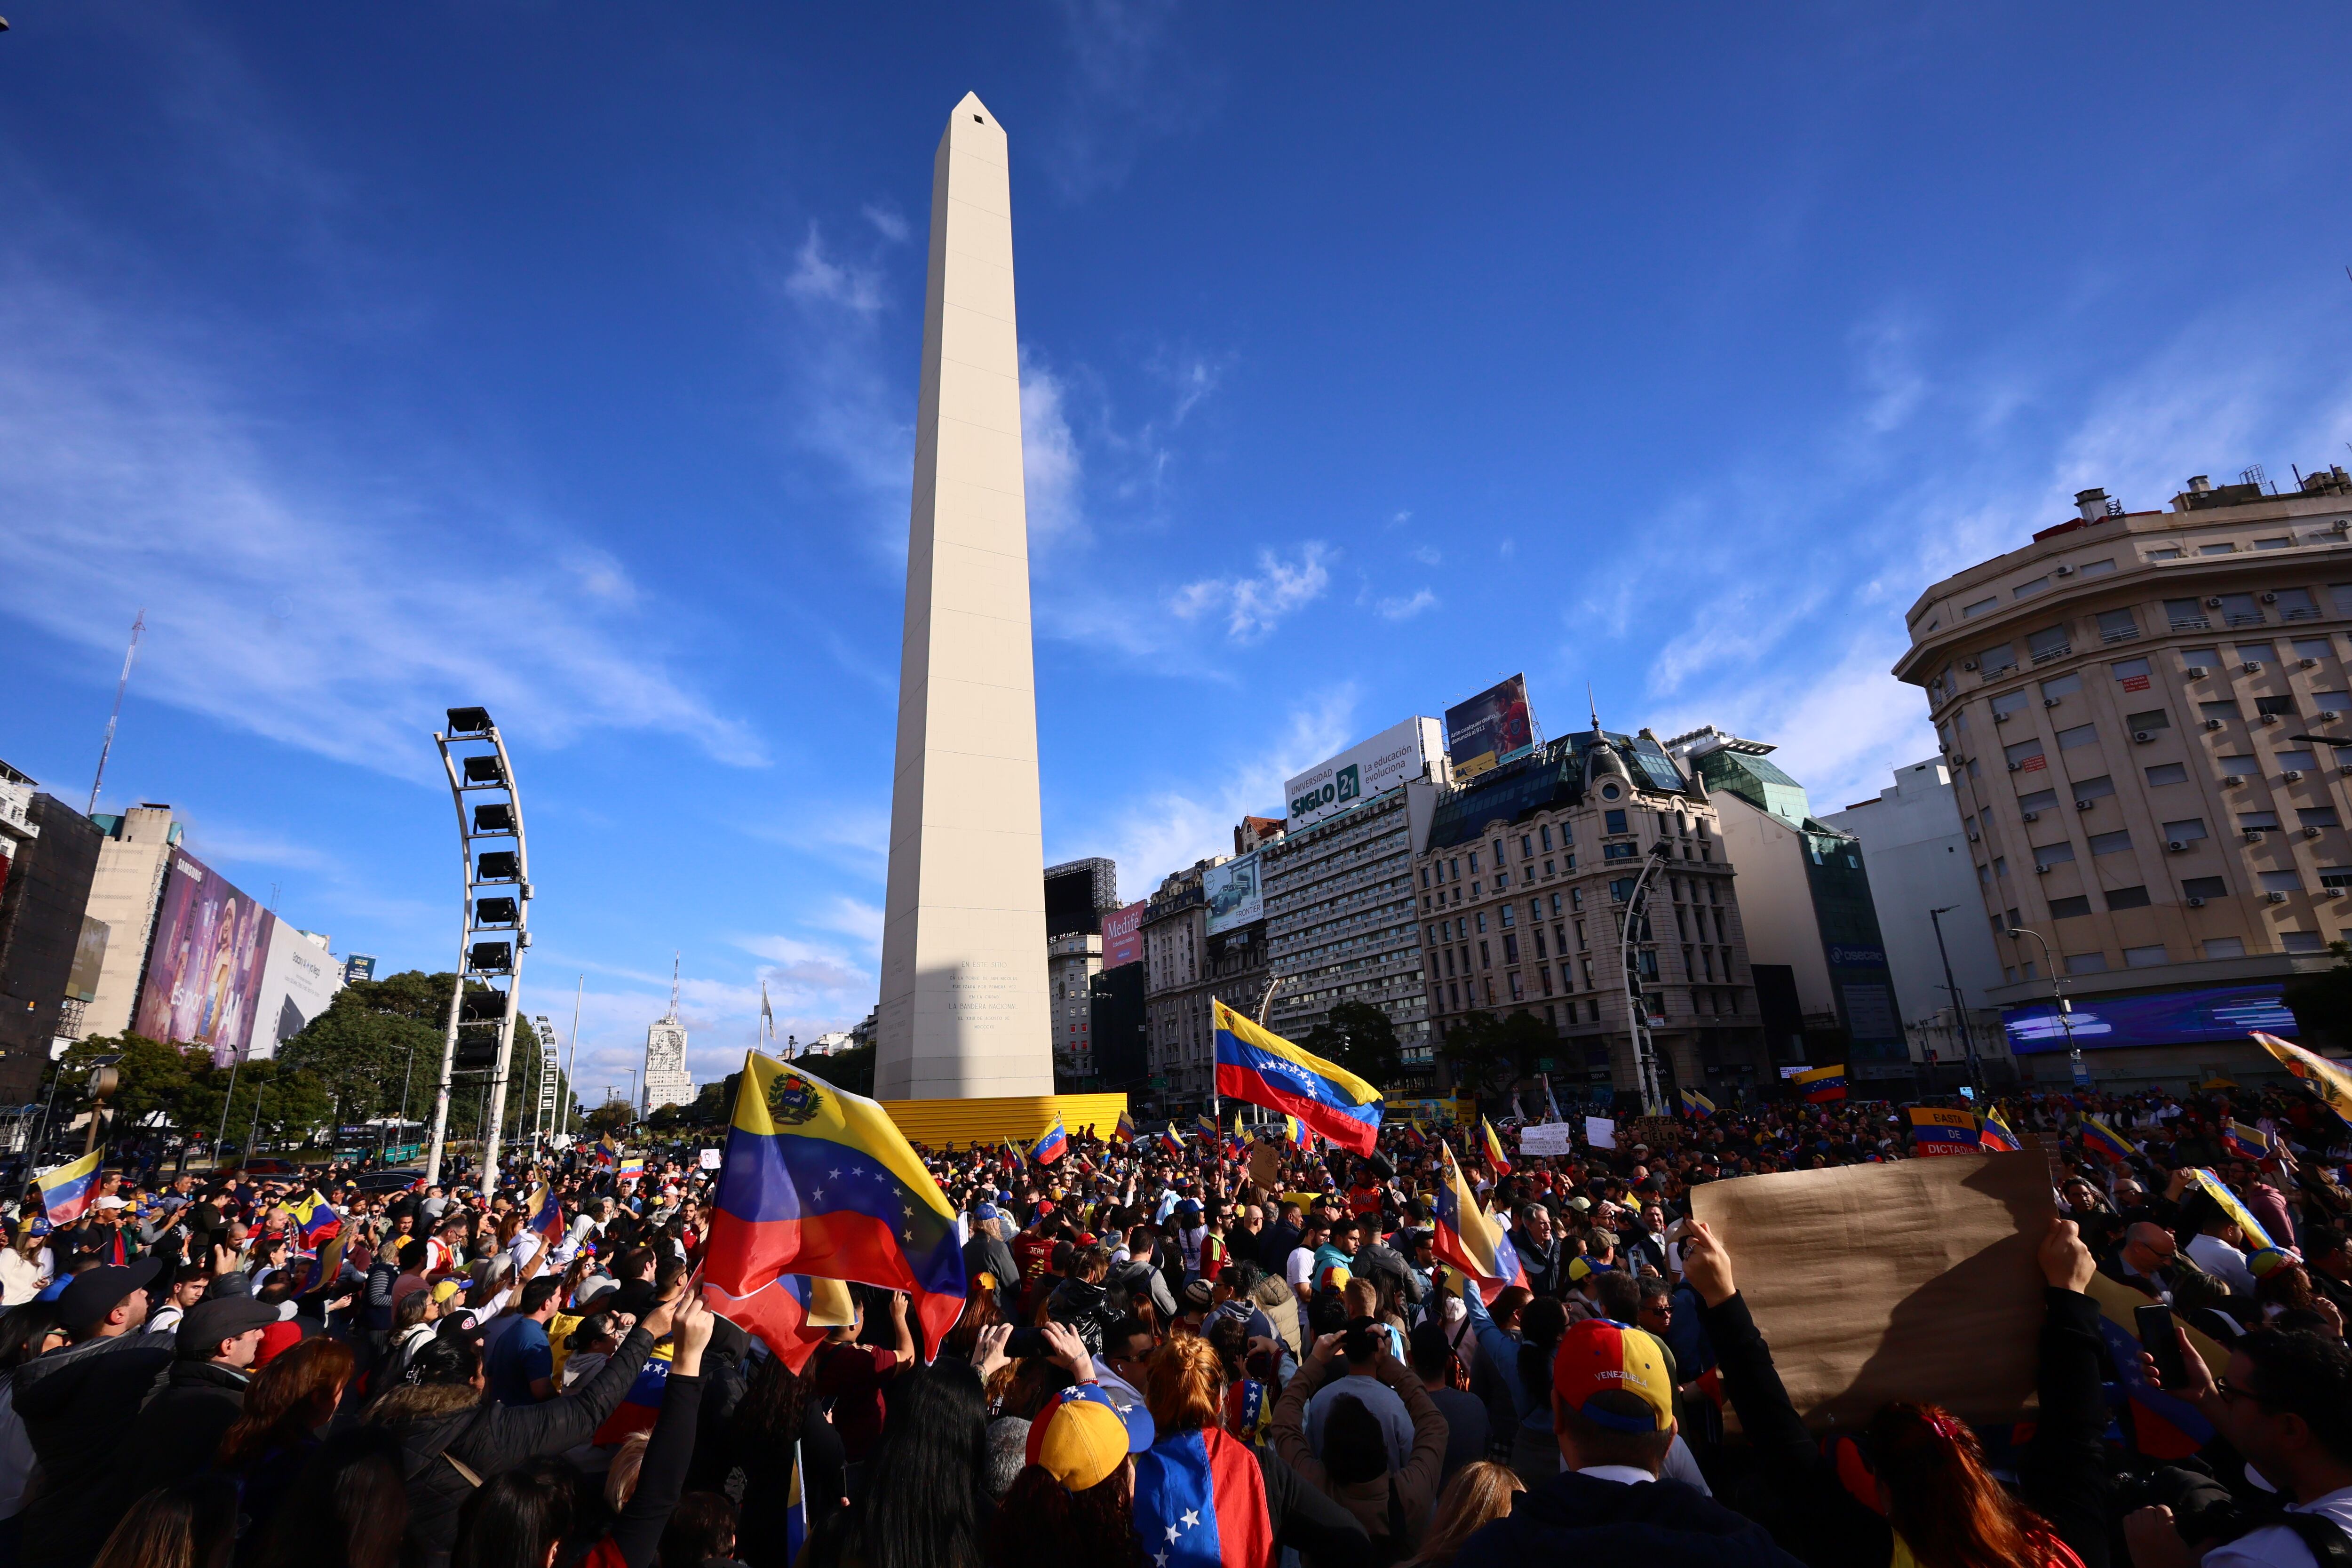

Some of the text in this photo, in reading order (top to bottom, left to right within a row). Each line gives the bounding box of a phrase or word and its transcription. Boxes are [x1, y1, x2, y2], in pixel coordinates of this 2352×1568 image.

[1461, 720, 1482, 733] cualquier
[1482, 714, 1497, 724] delito,
[1451, 730, 1471, 745] denunciá
[1364, 745, 1412, 773] La educación
[1366, 760, 1406, 784] evoluciona
[1291, 768, 1332, 795] UNIVERSIDAD
[1291, 774, 1354, 819] SIGLO 21
[177, 858, 202, 882] SAMSUNG
[1236, 904, 1261, 918] FRONTIER
[1107, 912, 1139, 939] Medifé
[293, 952, 303, 969] Galaxy
[1844, 951, 1883, 962] osecac
[171, 982, 184, 1006] Es
[183, 991, 203, 1015] por
[1638, 1116, 1674, 1126] FUERZA
[1933, 1114, 1964, 1125] BASTA
[1641, 1132, 1674, 1142] CIELO
[1947, 1130, 1962, 1139] DE
[1030, 1247, 1044, 1255] JEAN
[1594, 1370, 1647, 1389] VENEZUELA
